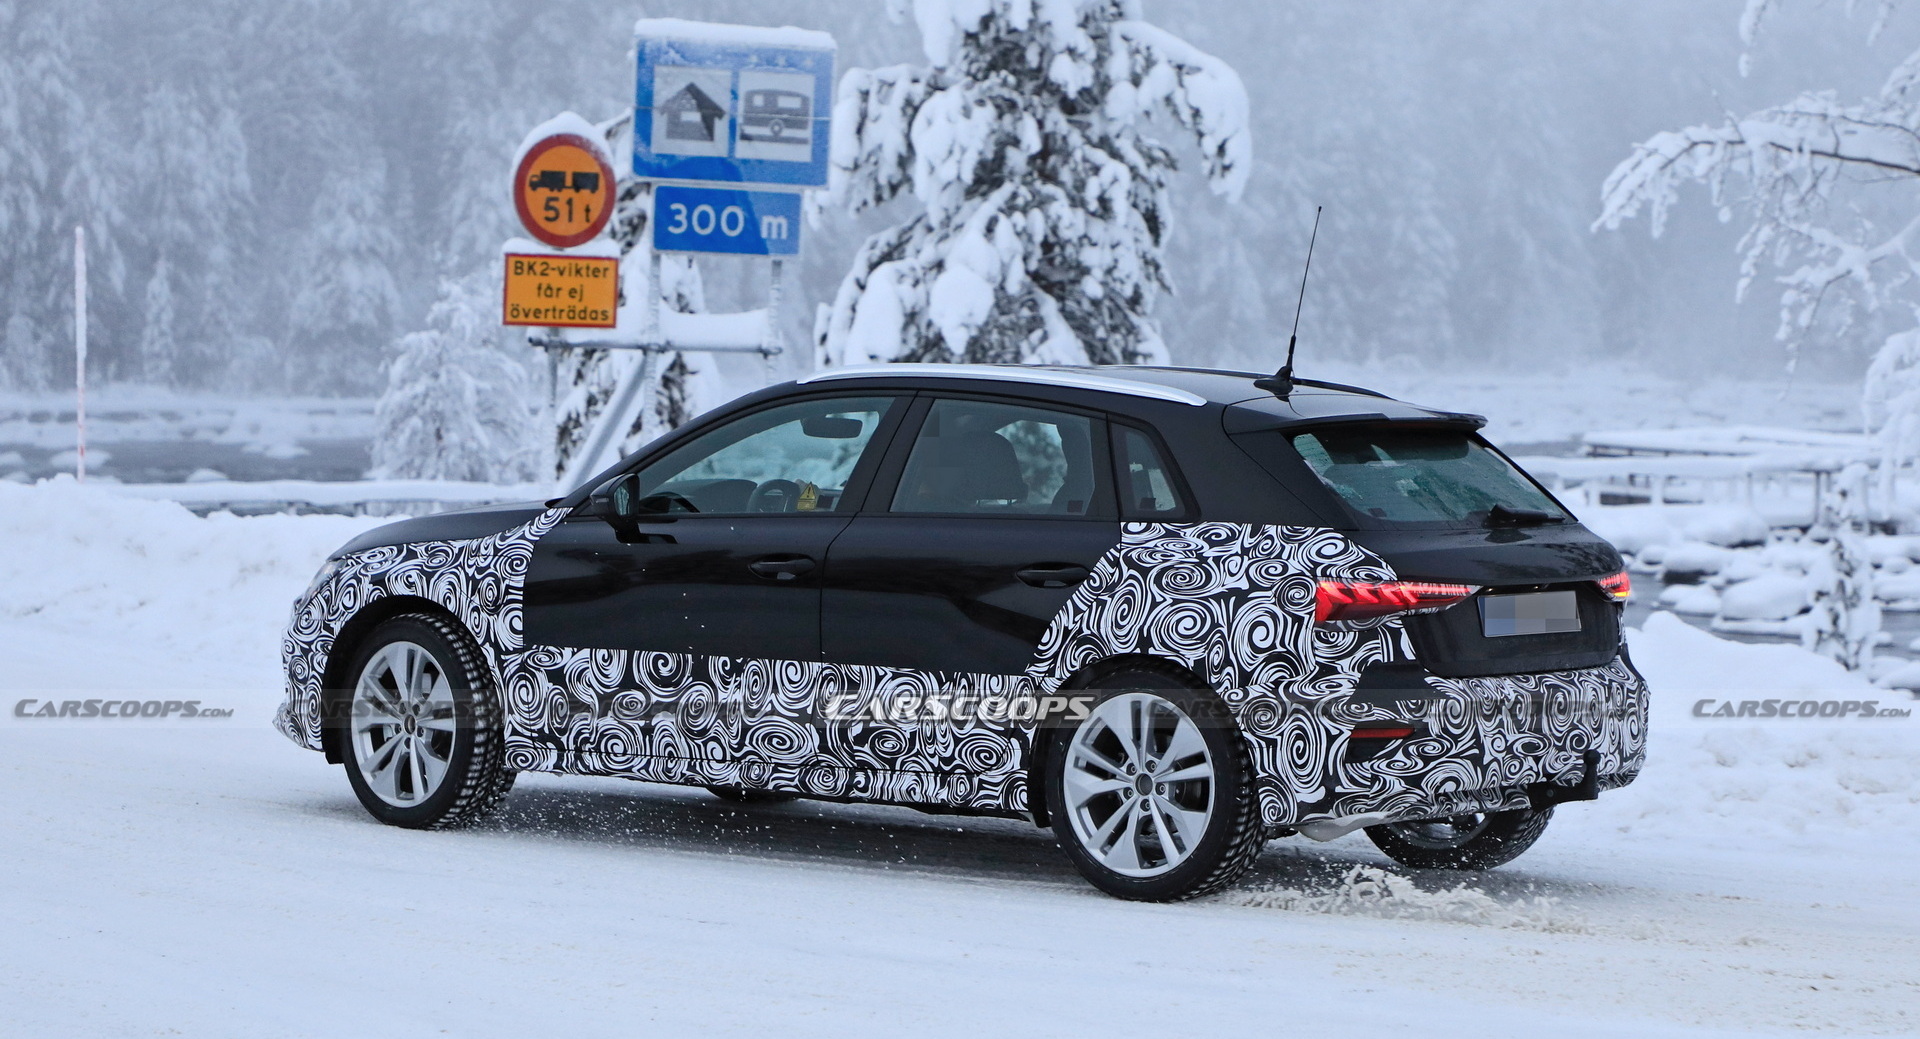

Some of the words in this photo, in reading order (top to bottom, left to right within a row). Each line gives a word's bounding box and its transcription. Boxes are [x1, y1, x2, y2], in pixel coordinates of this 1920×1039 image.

[543, 197, 573, 223] 51
[584, 204, 592, 223] t
[667, 203, 745, 237] 300
[760, 215, 788, 240] m
[513, 260, 610, 278] BK2-vikter
[537, 283, 563, 298] får
[568, 284, 584, 302] ej
[510, 303, 609, 321] överträdas
